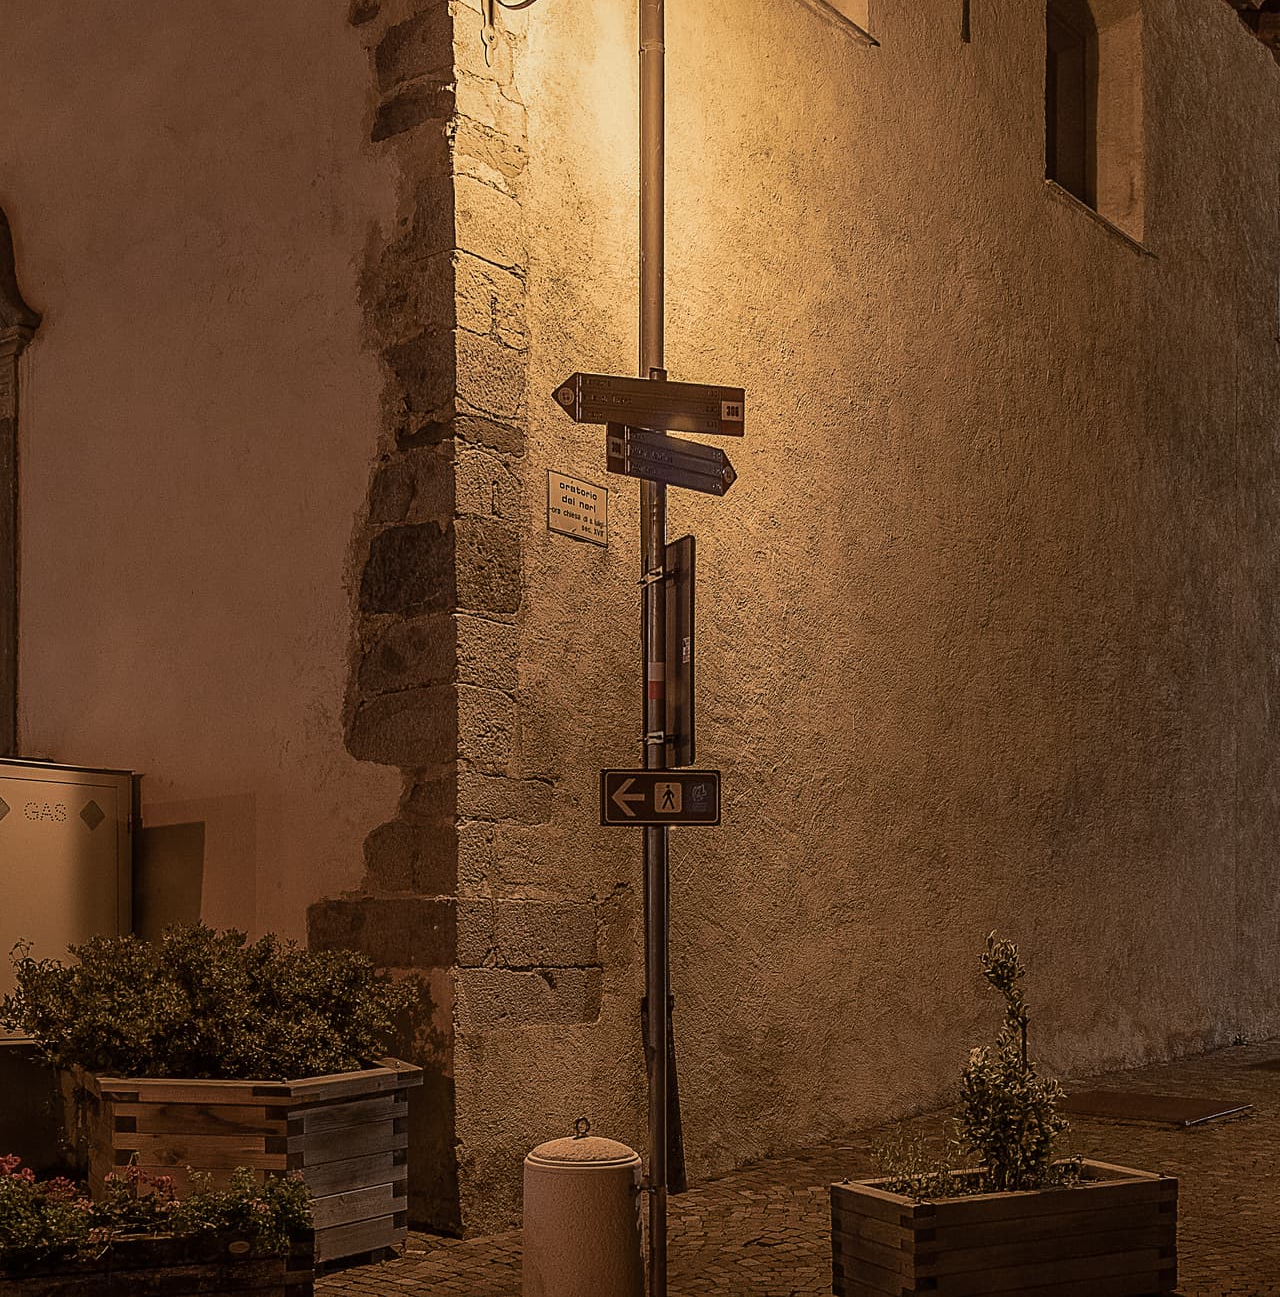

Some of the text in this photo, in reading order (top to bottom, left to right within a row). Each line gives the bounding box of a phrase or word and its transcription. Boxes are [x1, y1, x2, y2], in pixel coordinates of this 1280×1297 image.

[560, 482, 597, 500] oratorio
[562, 494, 596, 512] dei neri
[563, 510, 581, 520] chiesa
[24, 801, 67, 822] GAS
